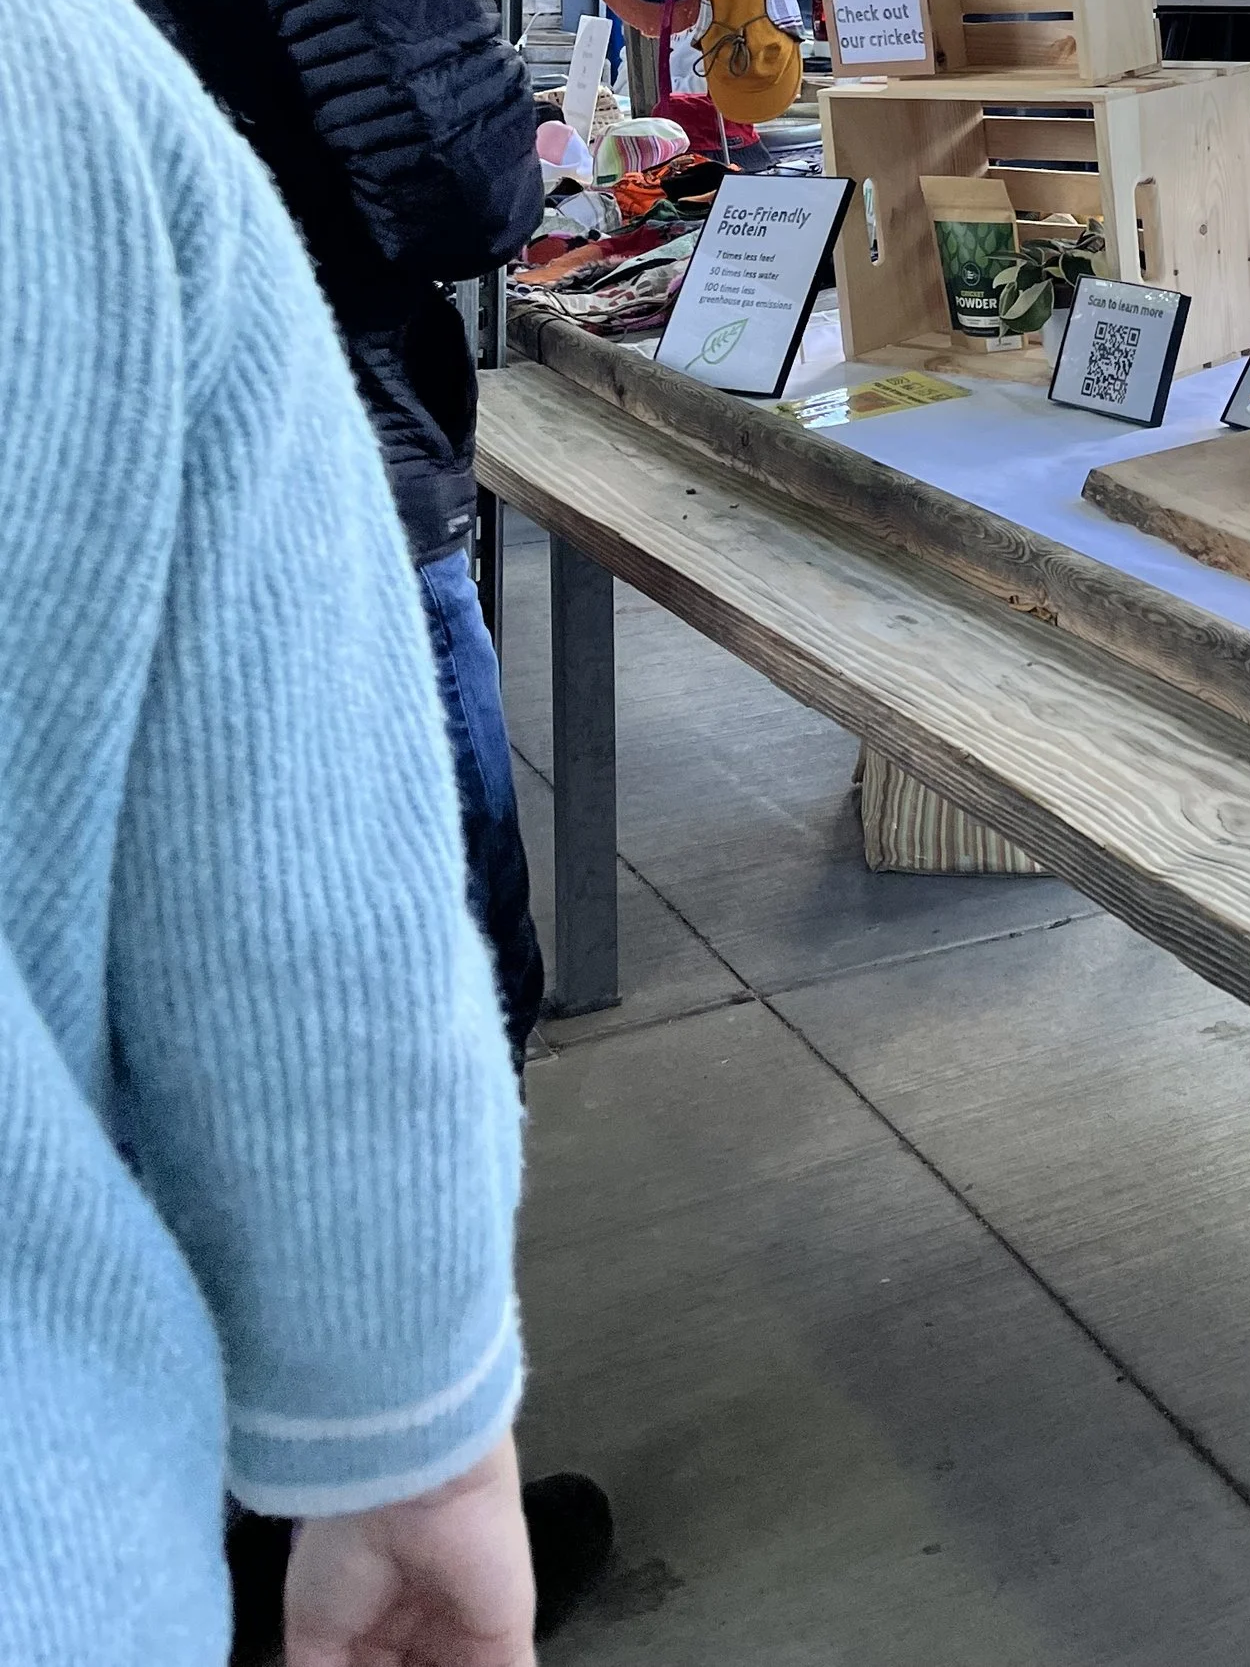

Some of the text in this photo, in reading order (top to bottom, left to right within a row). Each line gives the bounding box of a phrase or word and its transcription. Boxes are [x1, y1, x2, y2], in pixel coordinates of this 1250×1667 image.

[836, 4, 910, 24] Check out
[841, 28, 924, 49] our crickets
[723, 205, 812, 230] Eco-Friendly
[717, 221, 768, 237] Protein
[716, 250, 722, 259] 7
[722, 252, 742, 261] times
[743, 252, 757, 262] less
[709, 267, 780, 281] 50 times less water
[704, 282, 756, 295] 100 times less
[699, 295, 793, 310] greenhouse gas emissions
[955, 296, 997, 309] POWDER
[1088, 295, 1164, 318] Scan to learn more
